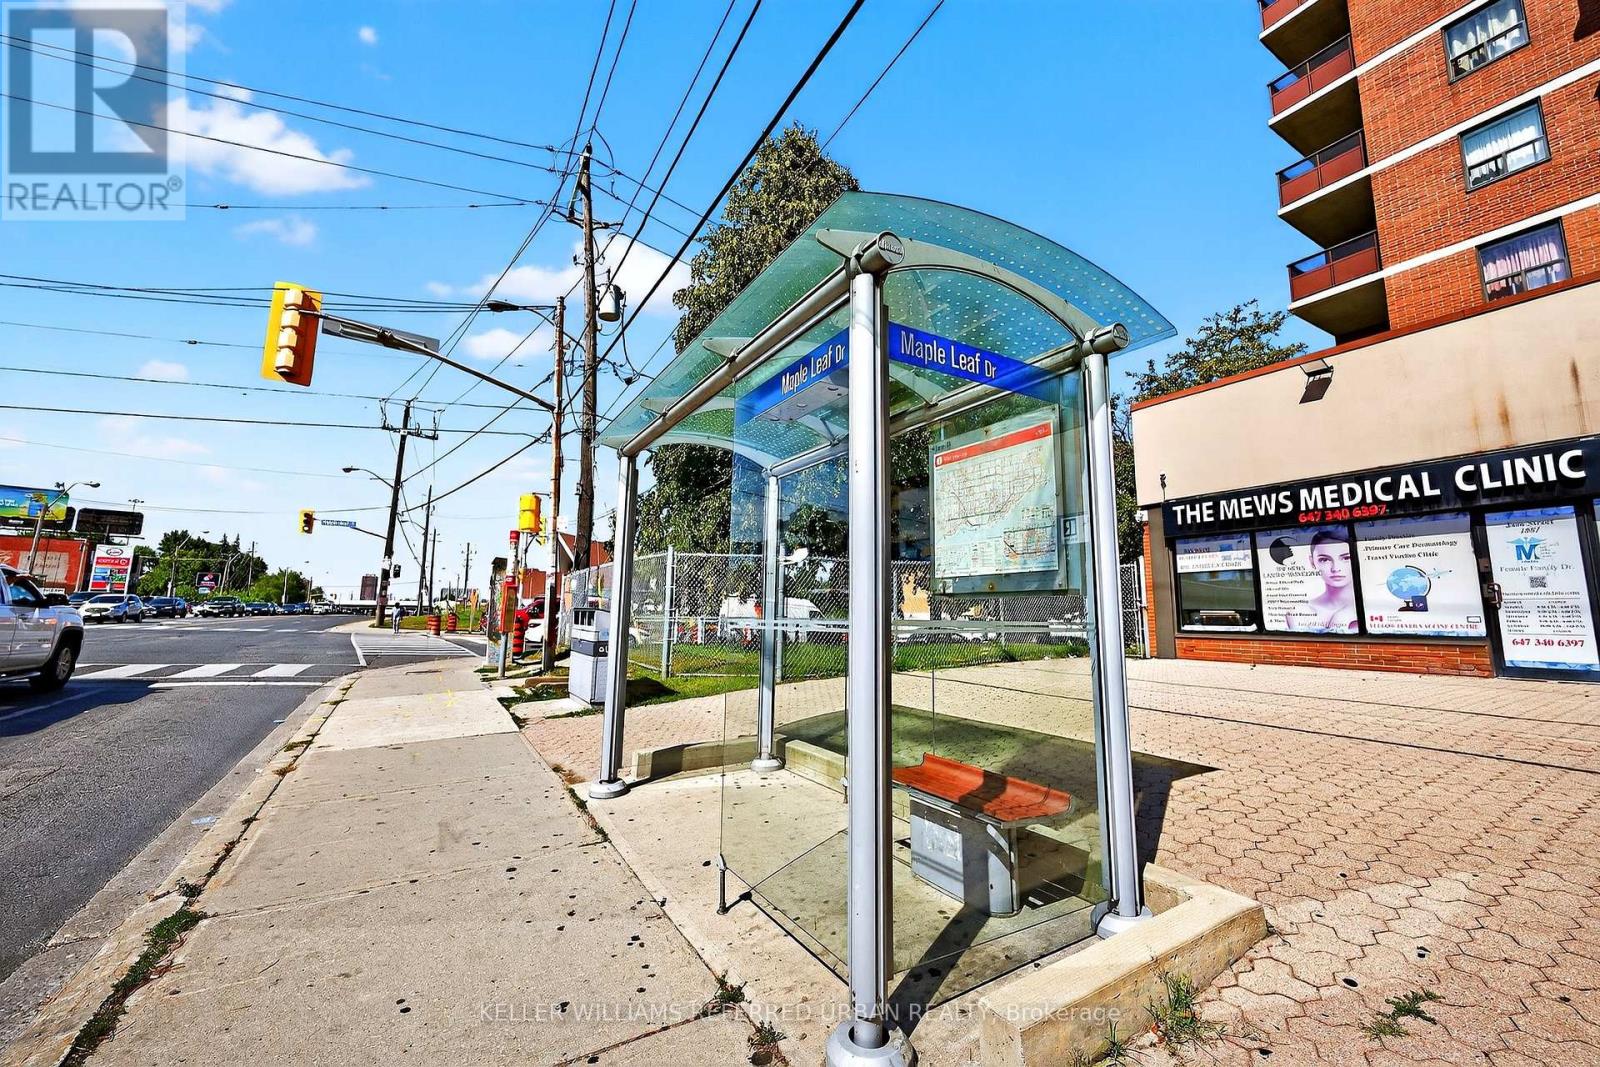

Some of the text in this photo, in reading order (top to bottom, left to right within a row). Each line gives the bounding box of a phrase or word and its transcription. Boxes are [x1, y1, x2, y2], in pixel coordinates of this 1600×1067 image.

[781, 343, 846, 395] Maple Leaf Dr
[901, 330, 997, 379] Maple Leaf Dr
[1172, 449, 1587, 526] THE MEWS MEDICAL CLINIC
[1298, 504, 1387, 524] 647 340 6397
[1512, 638, 1585, 648] 647 340 6397
